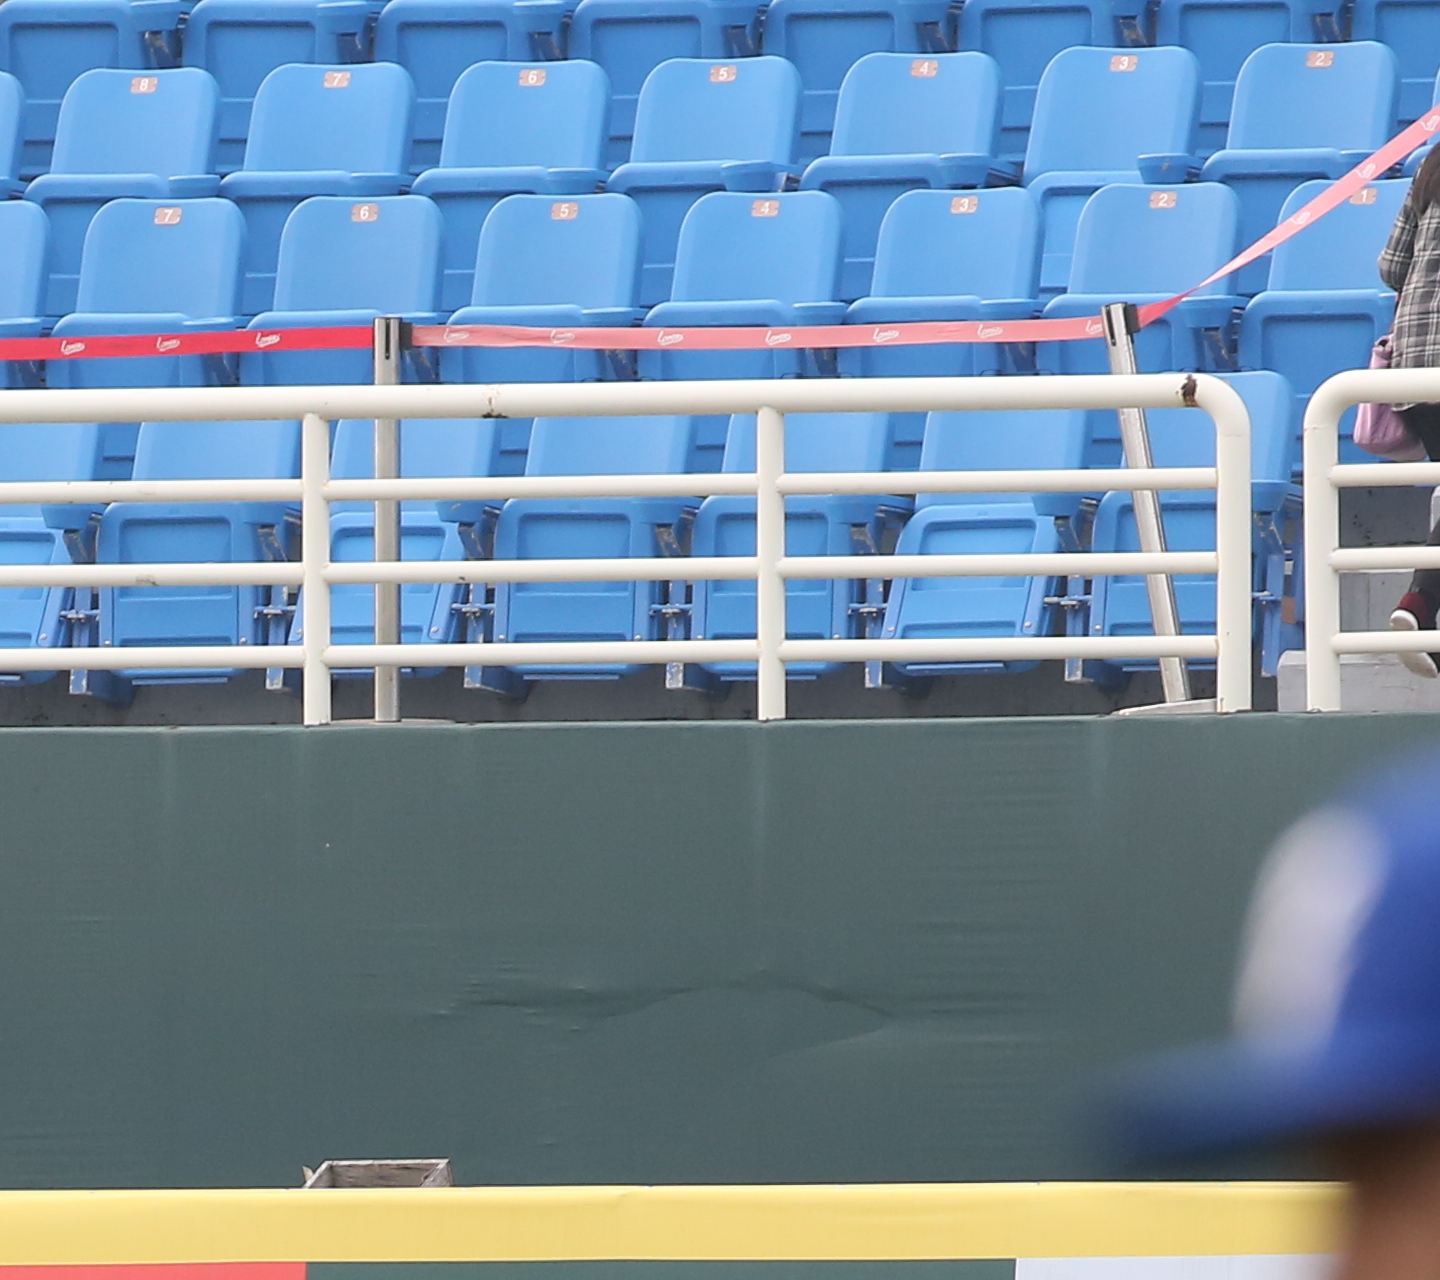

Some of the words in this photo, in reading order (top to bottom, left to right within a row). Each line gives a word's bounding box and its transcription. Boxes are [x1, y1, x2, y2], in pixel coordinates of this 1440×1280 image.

[1118, 56, 1129, 70] 3
[1315, 52, 1325, 66] 2
[718, 67, 728, 81] 5
[919, 61, 929, 75] 4
[332, 72, 343, 87] 7
[528, 70, 538, 84] 6
[139, 78, 149, 92] 8
[1157, 193, 1169, 207] 2
[1360, 189, 1368, 203] 1
[559, 203, 569, 218] 5
[760, 201, 770, 215] 4
[959, 198, 969, 212] 3
[163, 208, 174, 223] 7
[360, 205, 369, 220] 6
